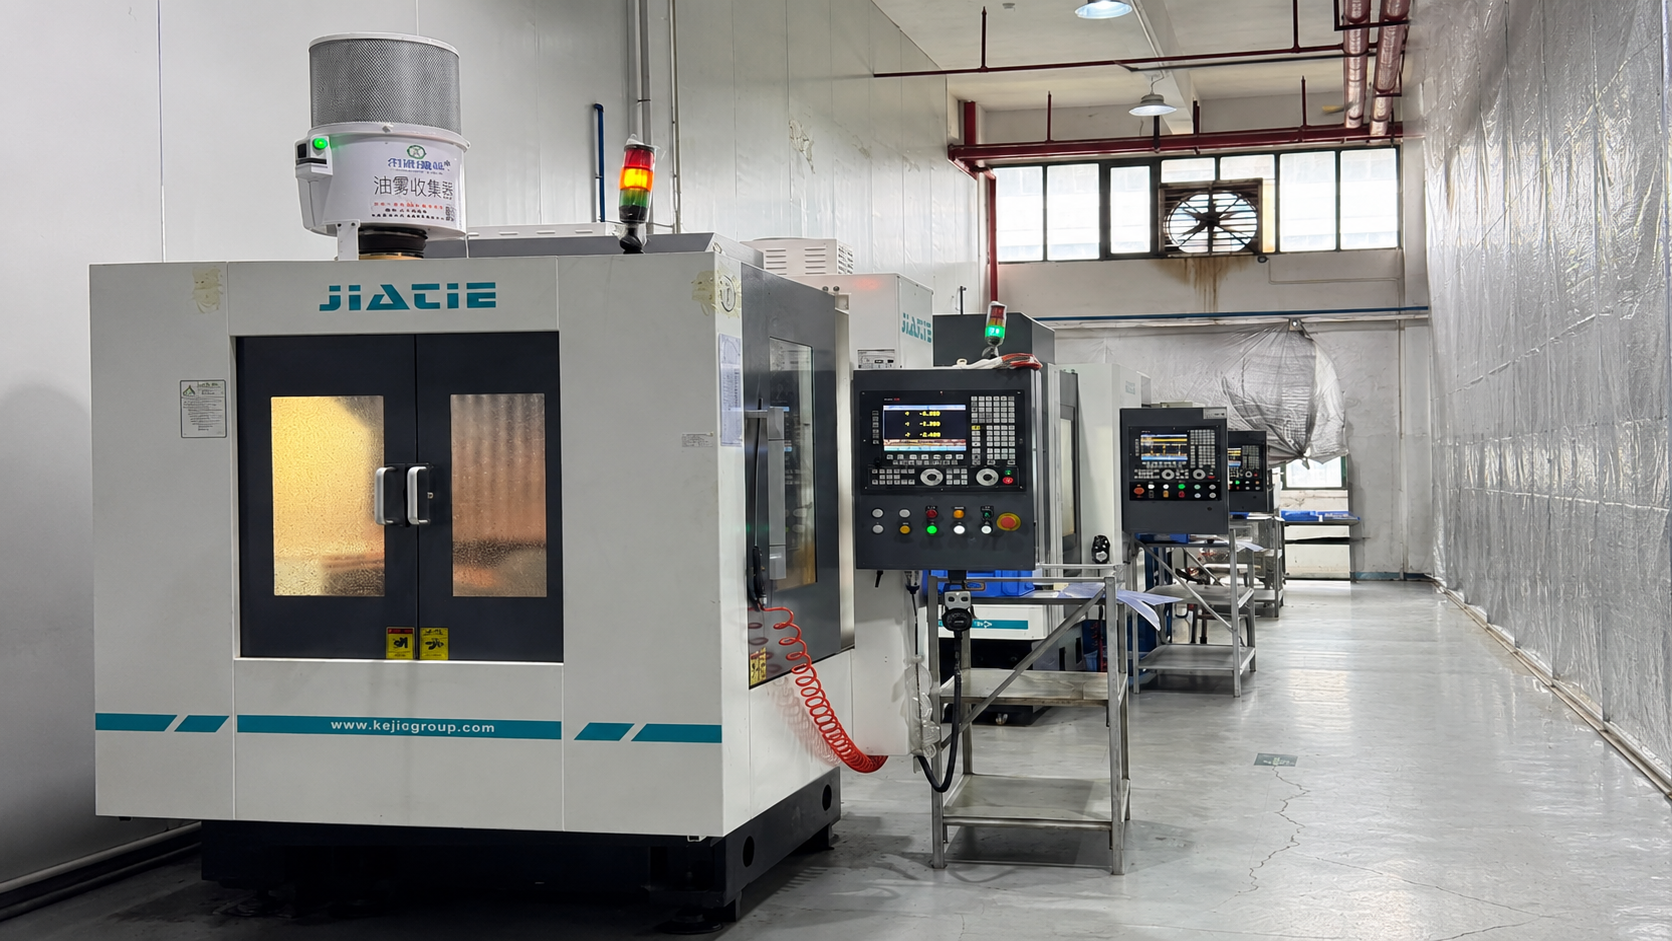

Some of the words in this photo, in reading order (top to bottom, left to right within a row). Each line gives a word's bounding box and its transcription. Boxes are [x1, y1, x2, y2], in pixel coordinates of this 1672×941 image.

[373, 175, 454, 200] 油雾收集器
